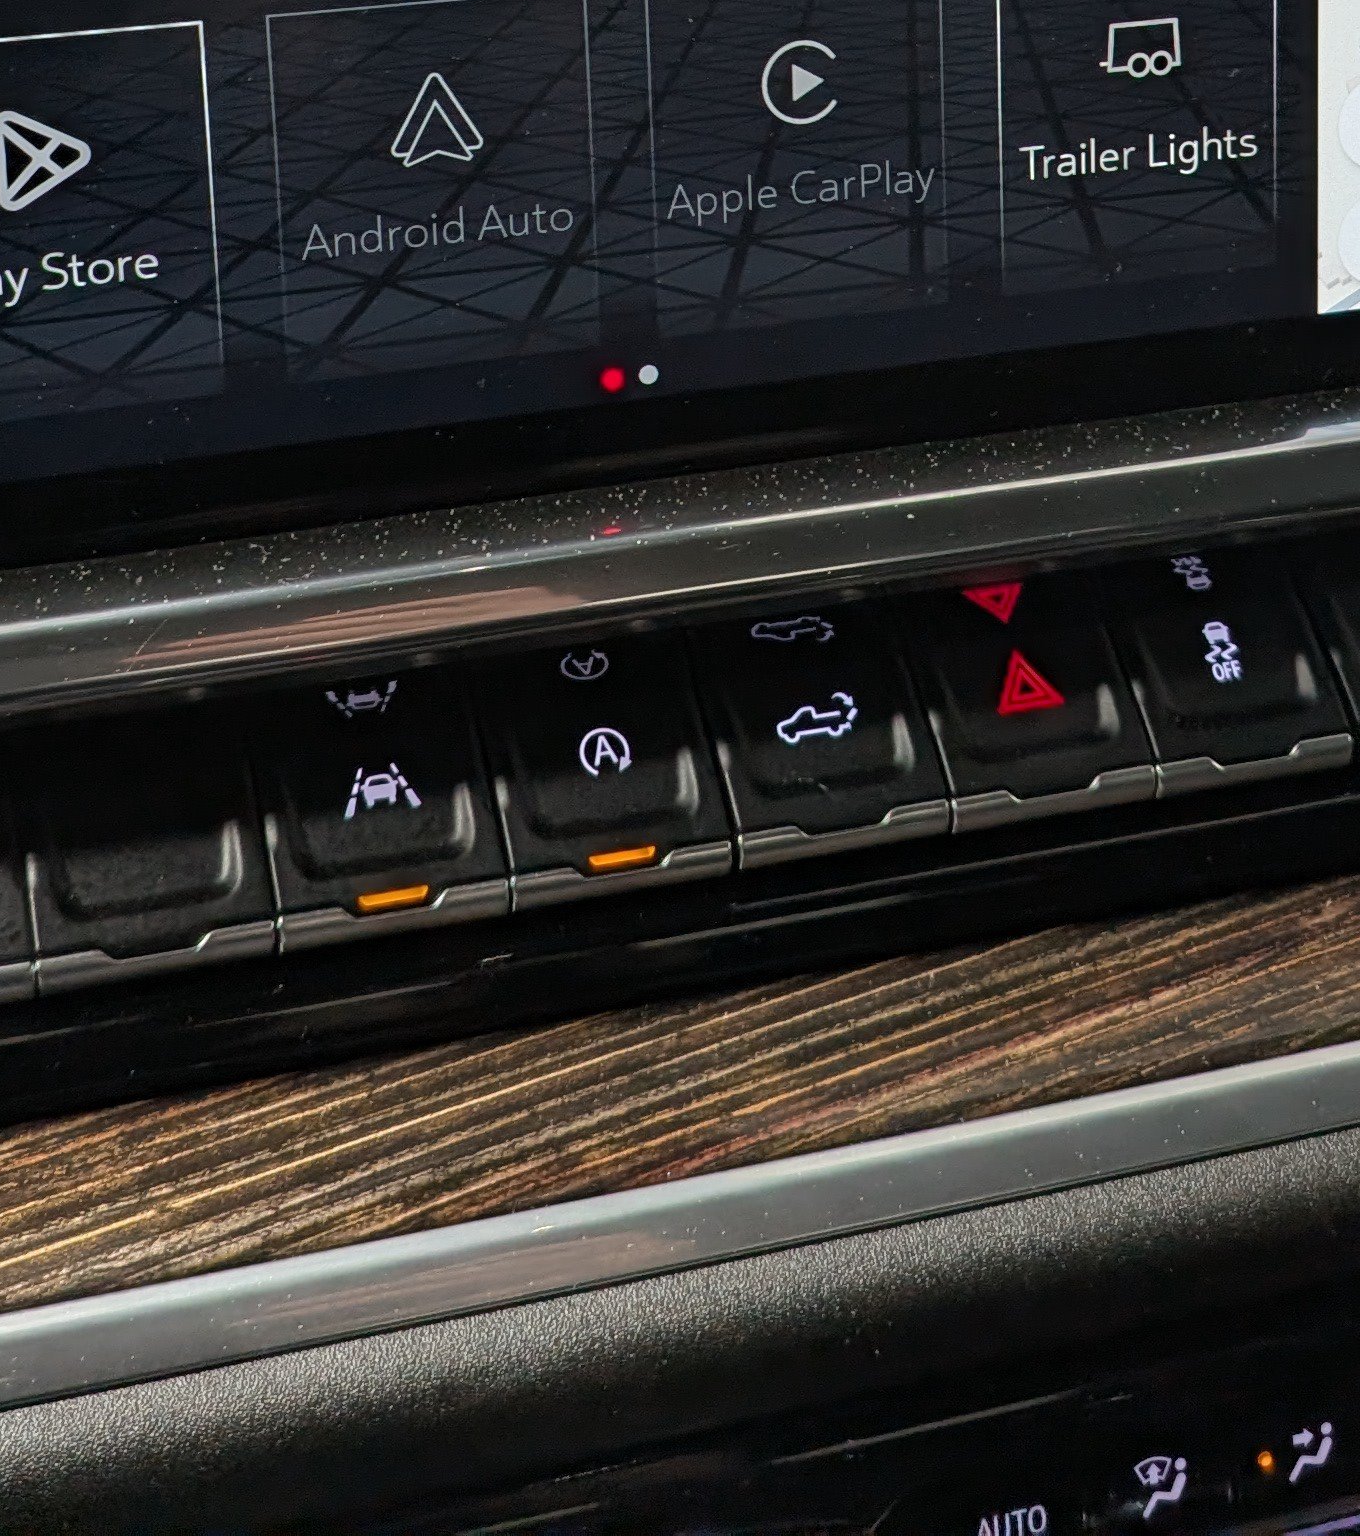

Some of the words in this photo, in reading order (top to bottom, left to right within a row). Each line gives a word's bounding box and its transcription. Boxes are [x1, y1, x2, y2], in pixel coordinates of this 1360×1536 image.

[1018, 137, 1136, 181] Trailer
[1148, 125, 1258, 175] Lights
[666, 173, 778, 227] Apple
[790, 159, 935, 205] CarPlay
[301, 205, 465, 261] Android
[477, 203, 574, 241] Auto
[41, 251, 159, 291] Store
[1211, 659, 1242, 682] OFF
[977, 1504, 1047, 1536] AUTO
